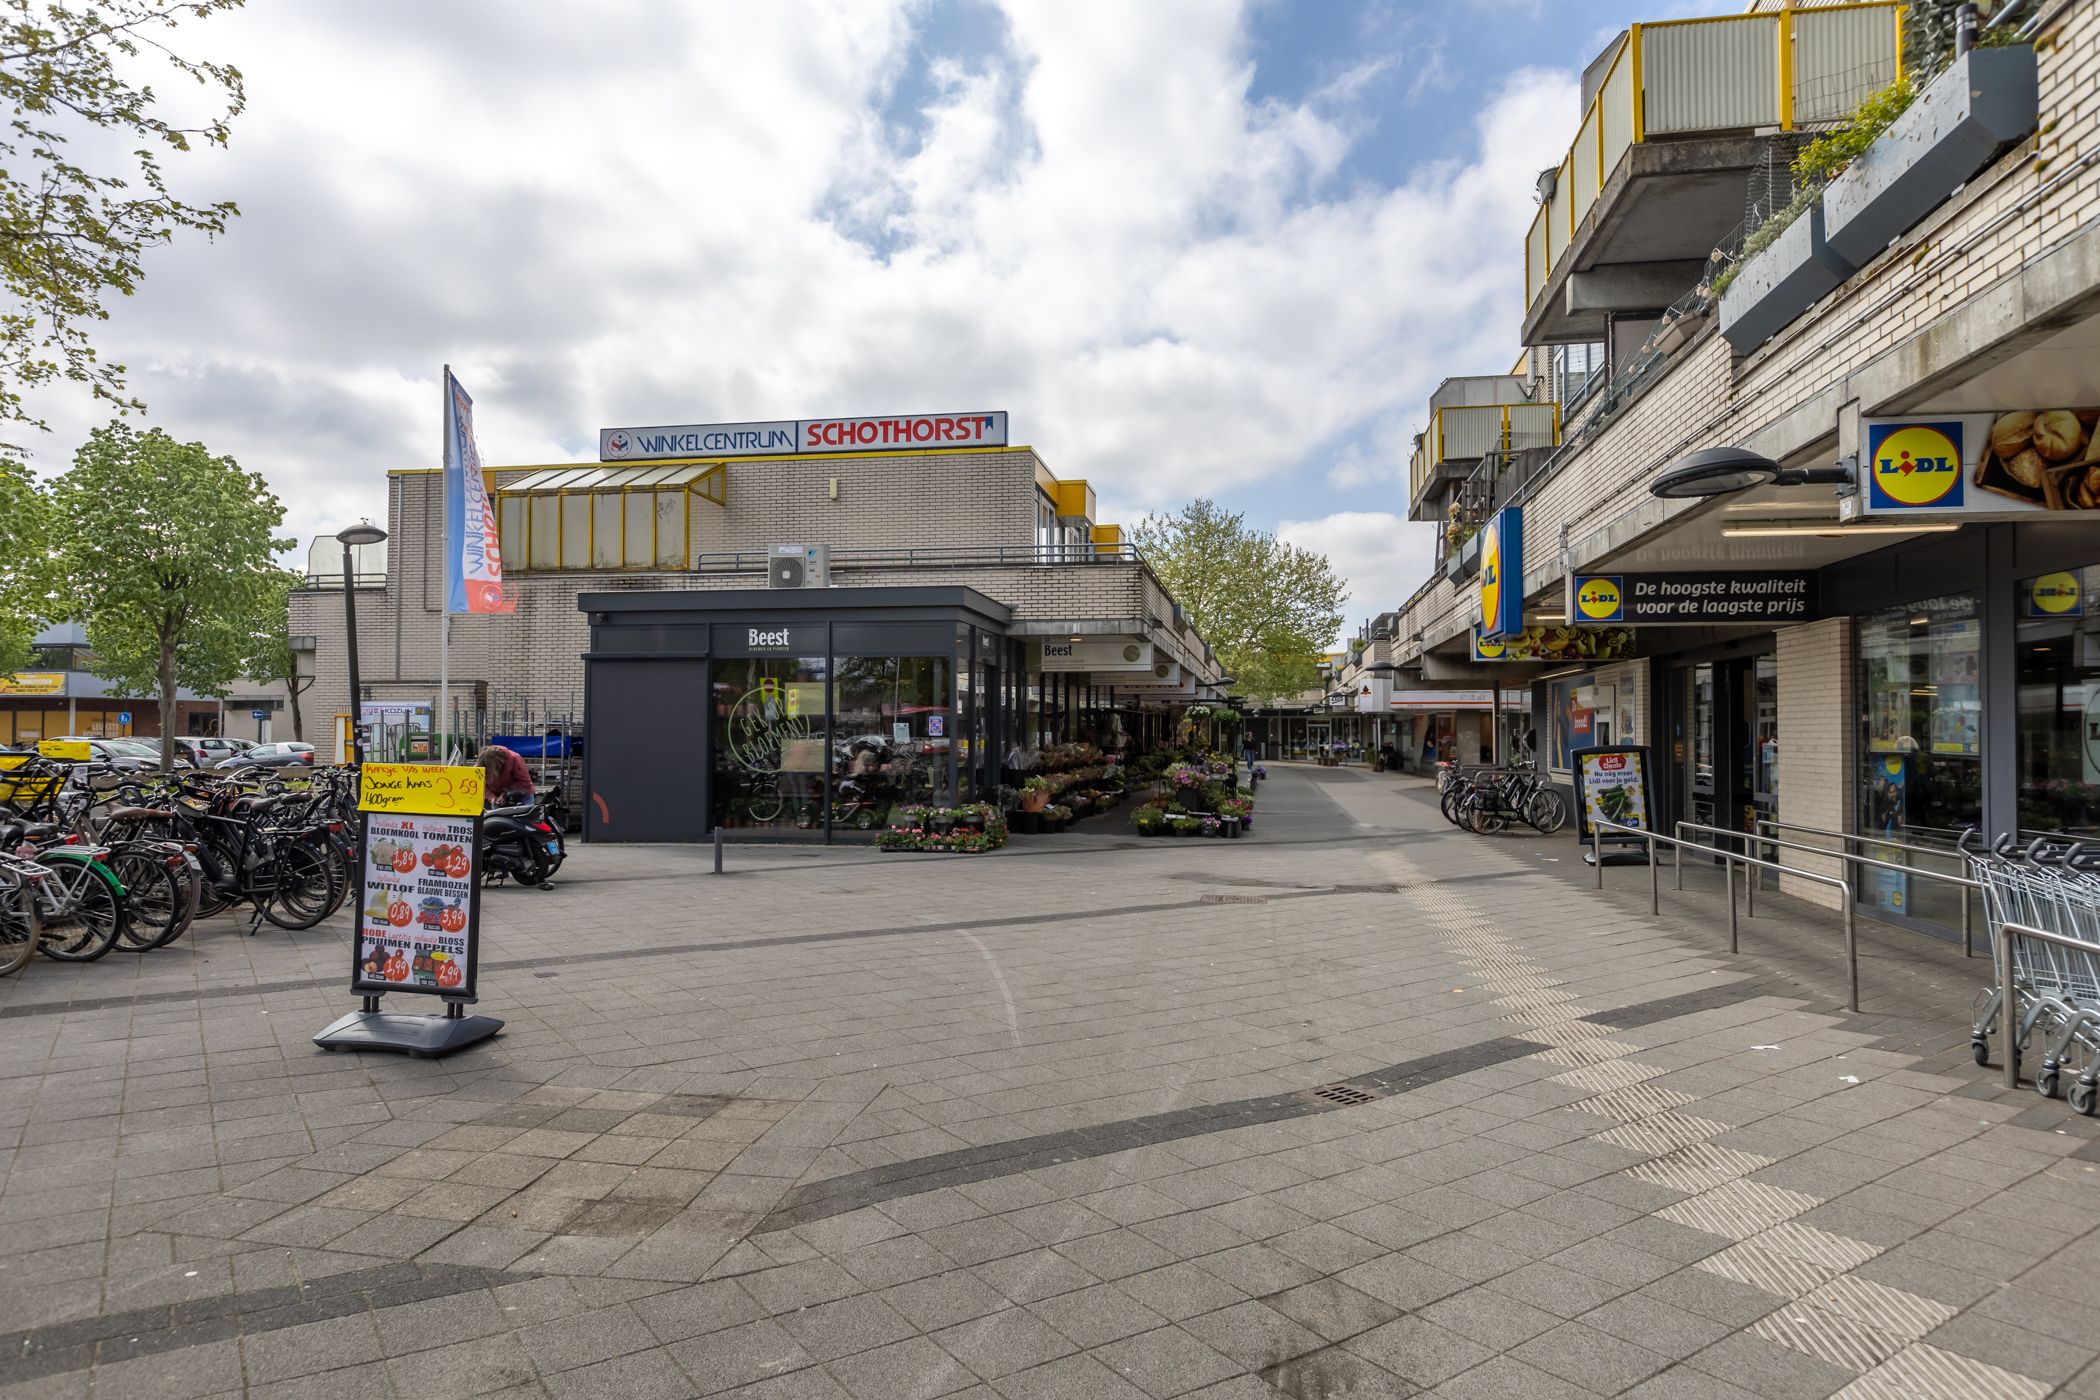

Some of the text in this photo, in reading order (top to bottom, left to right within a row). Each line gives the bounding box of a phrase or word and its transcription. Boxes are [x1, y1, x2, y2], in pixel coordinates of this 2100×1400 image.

[637, 417, 986, 453] WINKELCENTRUM SCHOTHORST
[1635, 579, 1806, 597] De hoogste kwaliteit
[1637, 598, 1805, 615] voor de laagste prijs
[748, 628, 789, 645] Beest
[1044, 644, 1072, 656] Beest
[435, 777, 478, 808] 3 59
[401, 821, 414, 830] XL
[447, 825, 472, 835] TROS
[370, 827, 419, 839] BLOEMKOOL
[422, 832, 472, 843] TOMATEN
[393, 850, 414, 867] 1,89
[446, 855, 467, 871] 1,29
[367, 881, 414, 893] WITLOF
[418, 878, 469, 890] FRAMBOZEN
[417, 887, 468, 898] BLAUWE BESSEN
[391, 904, 410, 921] 0,89
[442, 909, 463, 925] 3,99
[362, 936, 411, 949] PRUIMEN
[438, 936, 464, 946] BLOSS
[413, 942, 464, 955] APPELS
[387, 959, 406, 975] 1,99
[439, 966, 459, 982] 2,99
